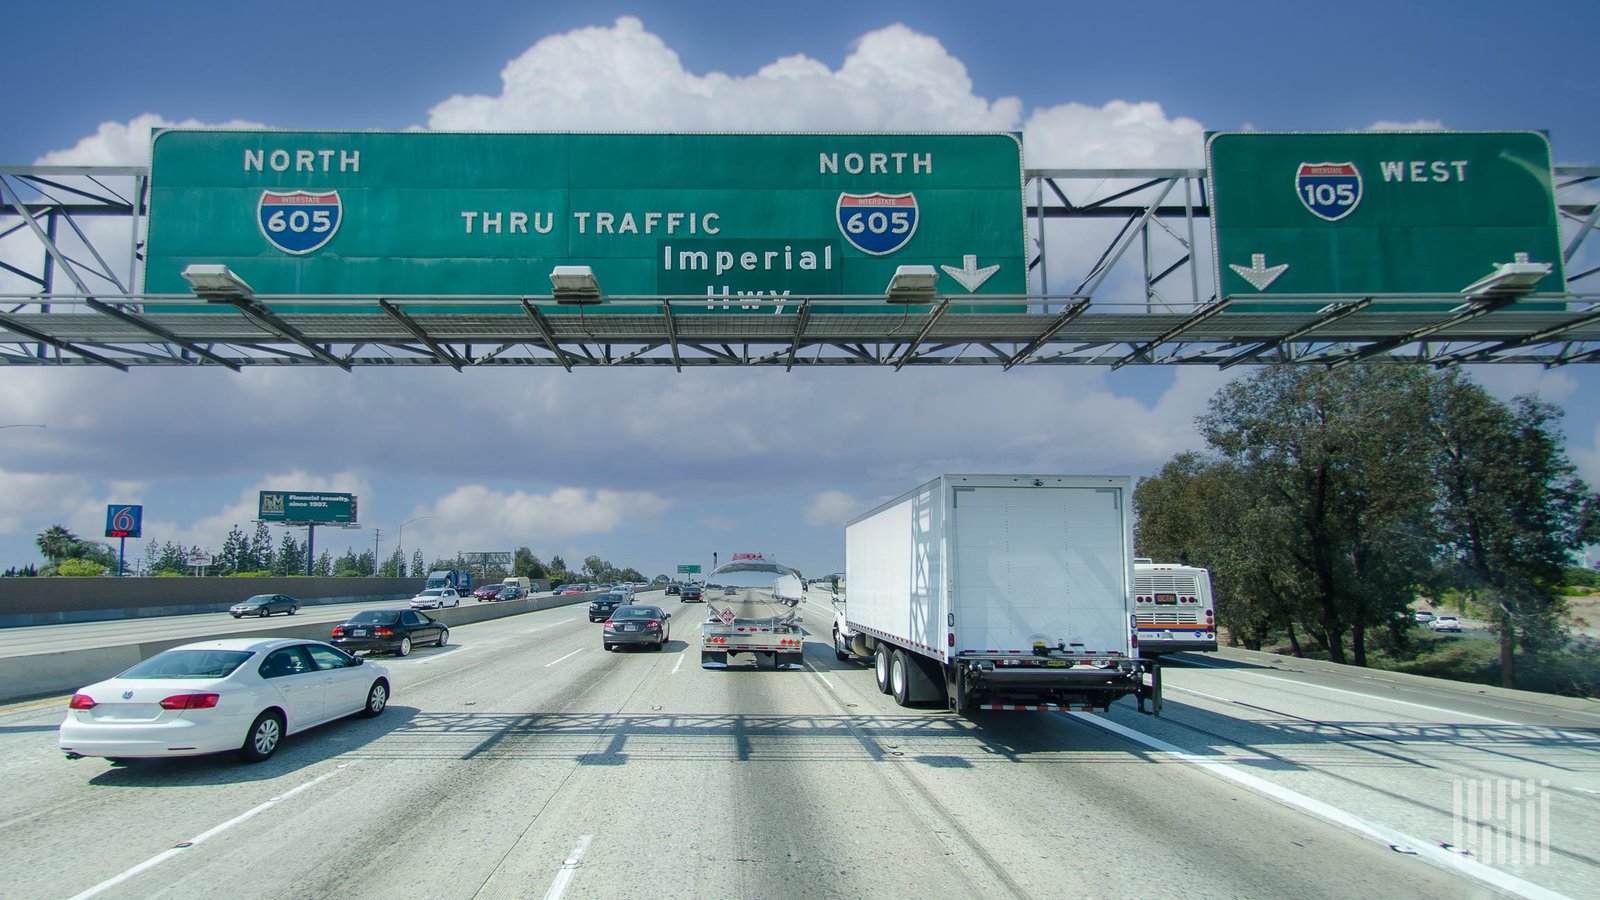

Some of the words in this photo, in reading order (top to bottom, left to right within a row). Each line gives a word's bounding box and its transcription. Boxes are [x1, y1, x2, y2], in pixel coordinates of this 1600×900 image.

[243, 149, 361, 173] NORTH
[819, 152, 933, 175] NORTH
[1310, 167, 1343, 175] INTERSTATE
[1380, 160, 1469, 184] WEST
[281, 196, 321, 204] INTERSTATE
[857, 197, 897, 206] INTERSTATE
[1304, 183, 1357, 206] 105
[267, 210, 332, 233] 605
[461, 211, 555, 235] THRU
[573, 211, 721, 235] TRAFFIC
[846, 211, 910, 235] 605
[664, 245, 832, 276] Imperial
[706, 285, 790, 315] Hwy
[113, 507, 134, 531] 6
